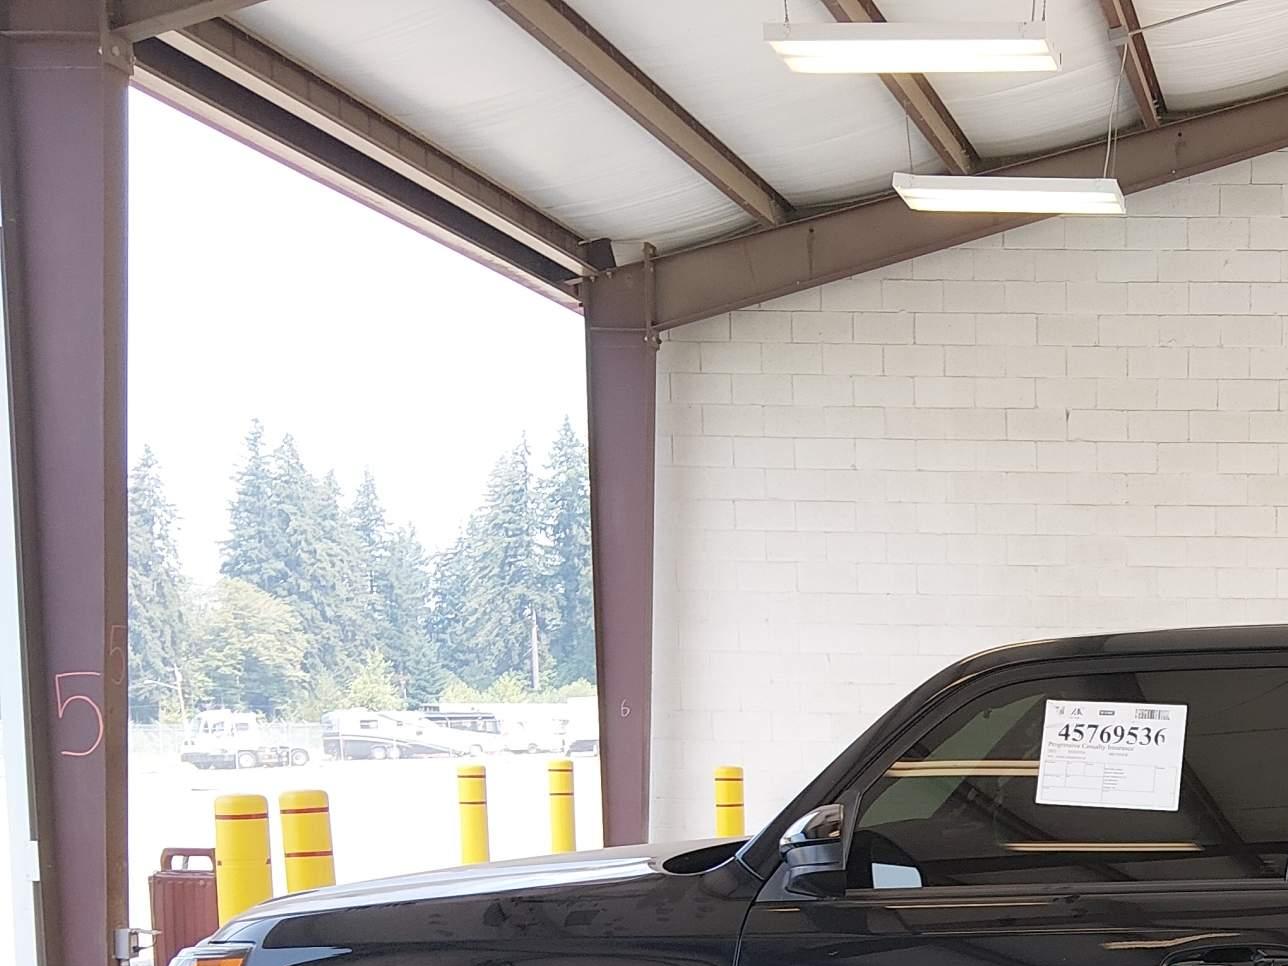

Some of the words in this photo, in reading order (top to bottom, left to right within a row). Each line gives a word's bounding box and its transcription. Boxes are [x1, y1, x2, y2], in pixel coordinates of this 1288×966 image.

[55, 671, 104, 757] 5
[620, 699, 631, 717] 6
[1058, 724, 1168, 746] 45769536
